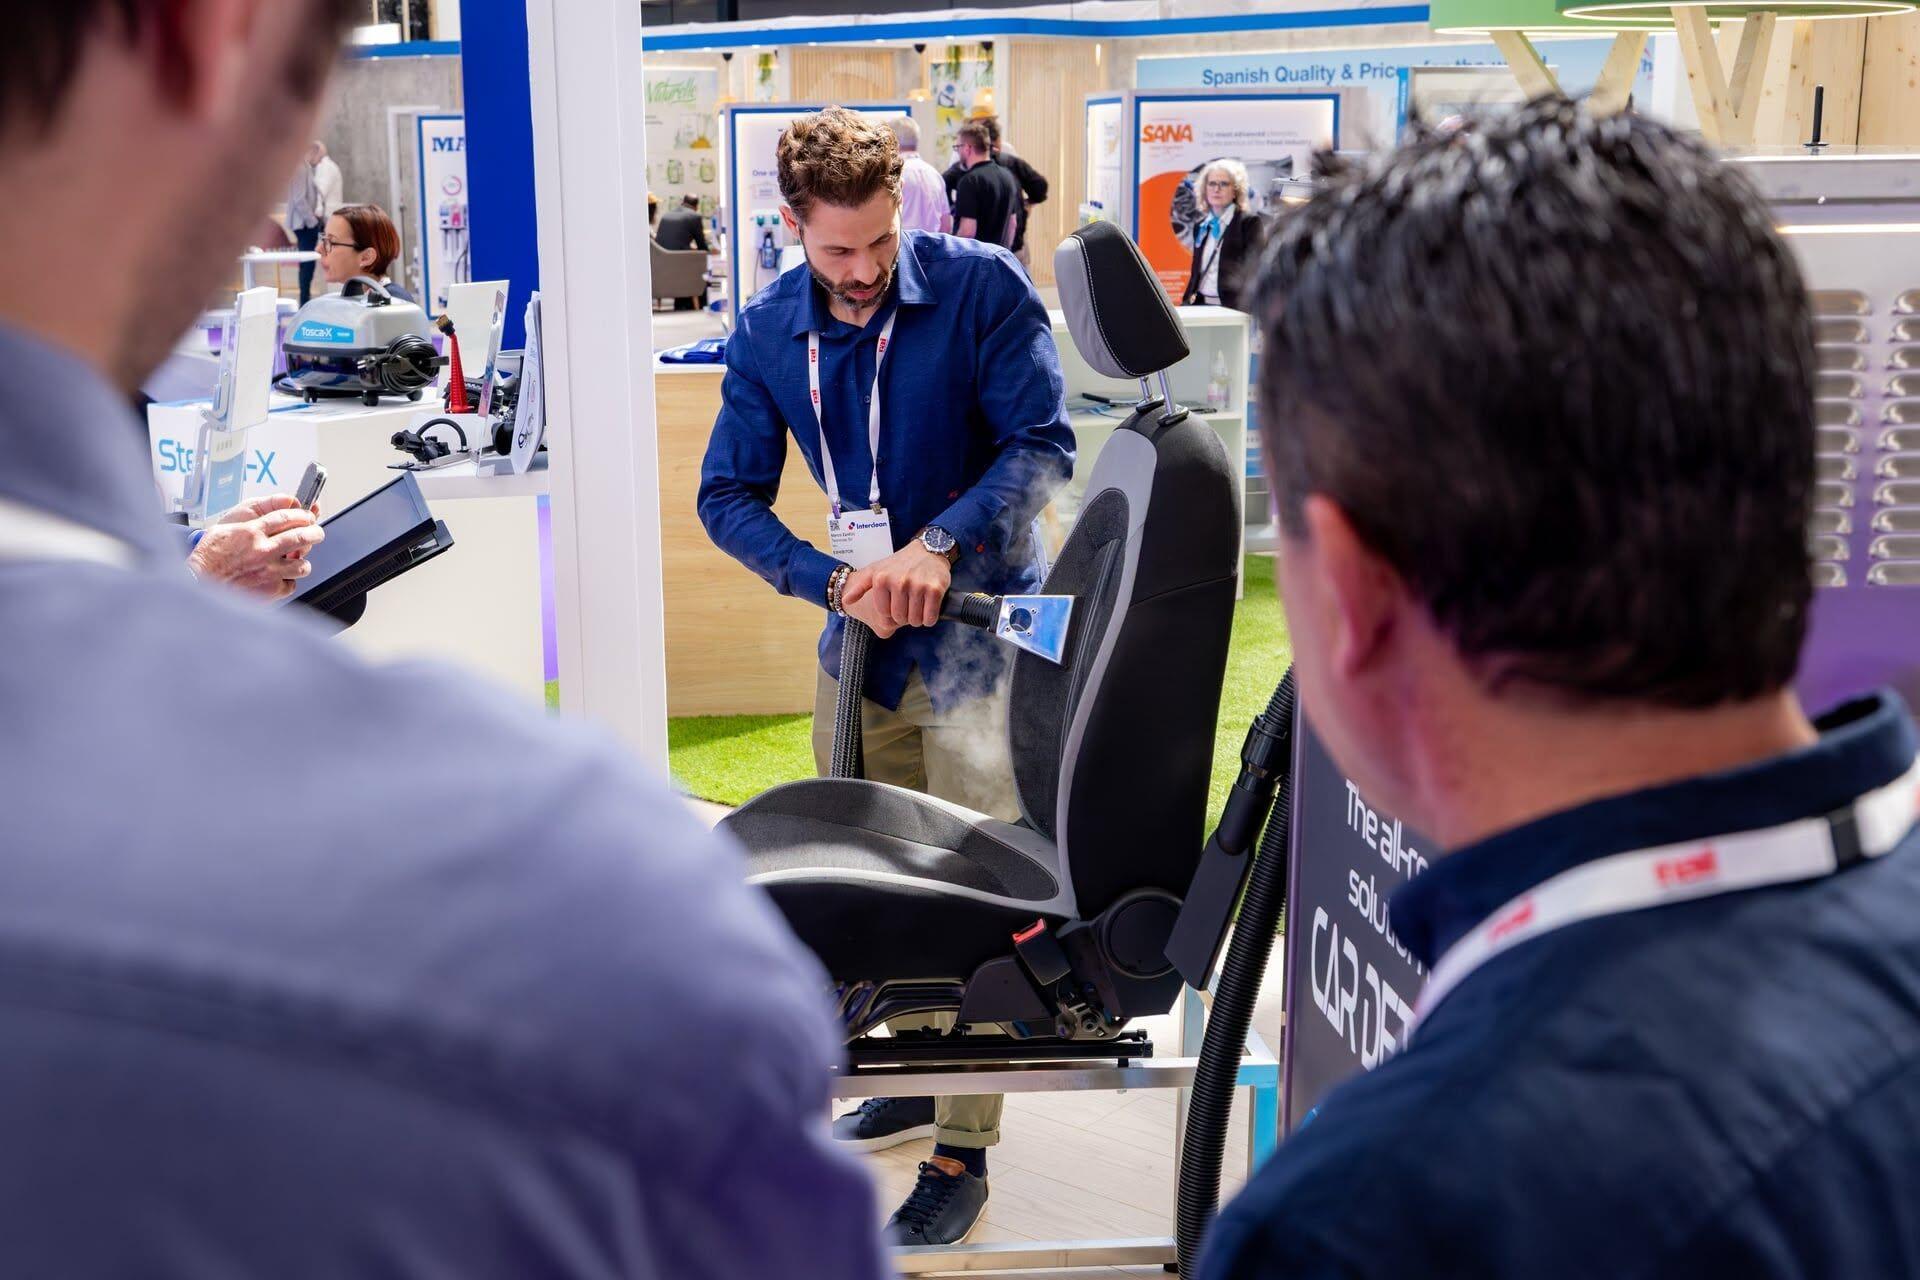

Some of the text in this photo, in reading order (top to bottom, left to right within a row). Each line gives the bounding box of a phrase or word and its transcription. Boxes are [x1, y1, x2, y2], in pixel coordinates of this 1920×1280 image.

[1203, 62, 1399, 87] Spanish Quality & Pric
[1141, 123, 1193, 143] SANA
[301, 326, 333, 338] Tosca-X
[856, 521, 888, 530] Interclean
[1345, 778, 1378, 850] The
[1348, 868, 1421, 976] solut
[1311, 906, 1359, 1054] CAR
